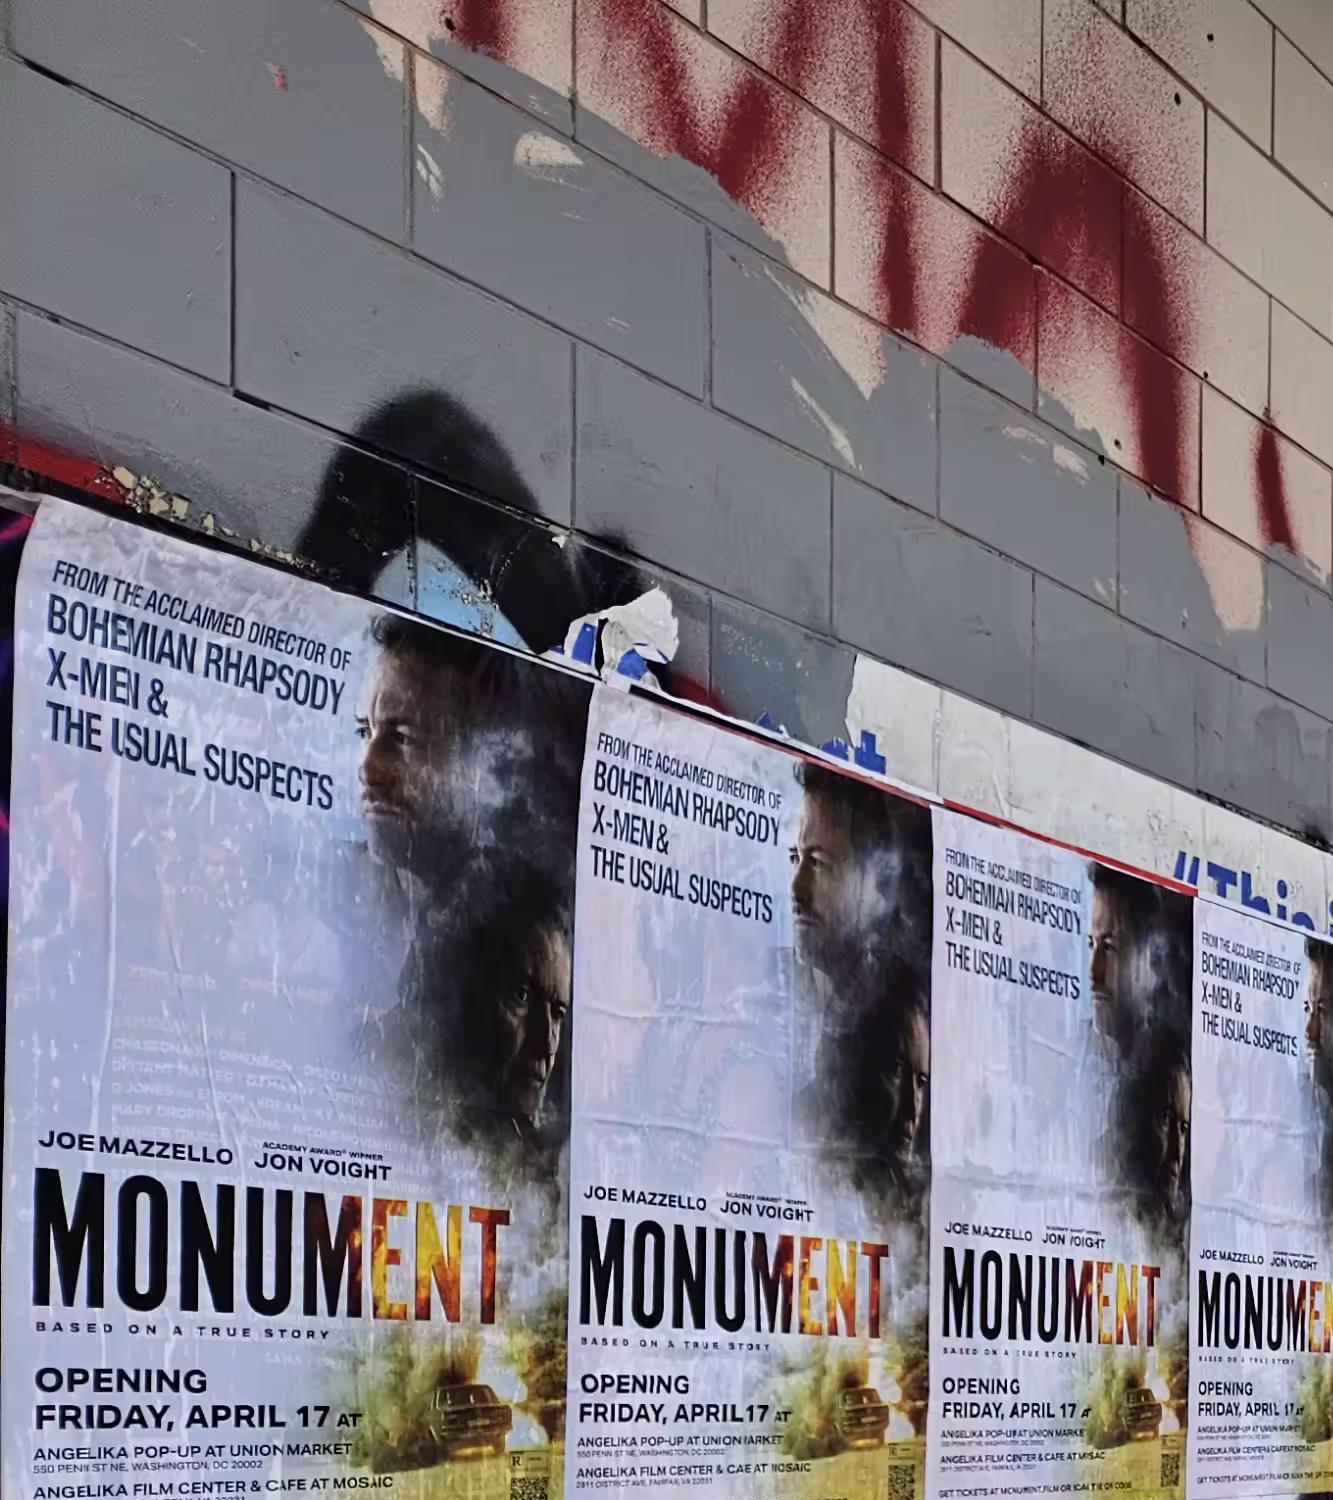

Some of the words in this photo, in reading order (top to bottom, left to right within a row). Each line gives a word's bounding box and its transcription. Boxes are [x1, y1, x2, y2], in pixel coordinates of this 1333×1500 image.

[52, 560, 109, 598] FROM
[113, 577, 144, 608] THE
[143, 590, 245, 639] ACCLAIMED
[247, 621, 327, 665] DIRECTOR
[330, 647, 352, 671] OF
[48, 593, 198, 674] BOHEMIAN
[203, 641, 345, 715] RHAPSODY
[47, 648, 140, 710] X-MEN
[147, 678, 168, 718] &
[46, 700, 102, 752] THE
[111, 718, 197, 777] USUAL
[204, 743, 333, 810] SUSPECTS
[594, 759, 689, 819] BOHEMIAN
[692, 792, 780, 846] RHAPSODY
[946, 870, 1015, 915] BOHEMIAN
[1018, 893, 1081, 935] RHAPSODY
[1202, 951, 1251, 987] BOHEMIAN
[1252, 967, 1300, 1000] RHAPSODY
[38, 1130, 95, 1152] JOE
[99, 1136, 233, 1165] MAZZELLO
[262, 1141, 307, 1153] ACADEMY
[254, 1152, 303, 1172] JON
[309, 1157, 392, 1181] VOIGHT
[33, 1167, 511, 1325] MONUMENT
[580, 1215, 889, 1339] MONUMENT
[942, 1246, 1161, 1347] MONUMENT
[36, 1322, 113, 1334] BASED
[128, 1324, 156, 1335] ON
[173, 1325, 183, 1336] A
[196, 1326, 251, 1338] TRUE
[264, 1328, 329, 1340] STORY
[35, 1367, 206, 1394] OPENING
[581, 1373, 689, 1394] OPENING
[942, 1377, 1020, 1395] OPENING
[1198, 1381, 1253, 1396] OPENING
[36, 1404, 174, 1432] FRIDAY,
[185, 1404, 286, 1428] APRIL
[296, 1406, 330, 1427] 17
[337, 1412, 362, 1433] AT
[33, 1446, 128, 1461] ANGELIKA
[134, 1445, 201, 1458] POP-UP
[204, 1445, 226, 1457] AT
[230, 1444, 285, 1457] UNION
[287, 1443, 352, 1457] MARKET
[33, 1464, 55, 1474] 550
[92, 1463, 108, 1472] ST
[110, 1462, 128, 1472] NE,
[131, 1461, 210, 1471] WASHINGTON,
[212, 1460, 229, 1470] DC
[231, 1460, 263, 1469] 20002
[33, 1484, 128, 1499] ANGELIKA
[133, 1482, 173, 1496] FILM
[178, 1480, 246, 1494] CENTER
[250, 1480, 261, 1492] &
[265, 1478, 306, 1492] CAFE
[310, 1478, 330, 1490] AT
[333, 1476, 394, 1489] MOSAIC
